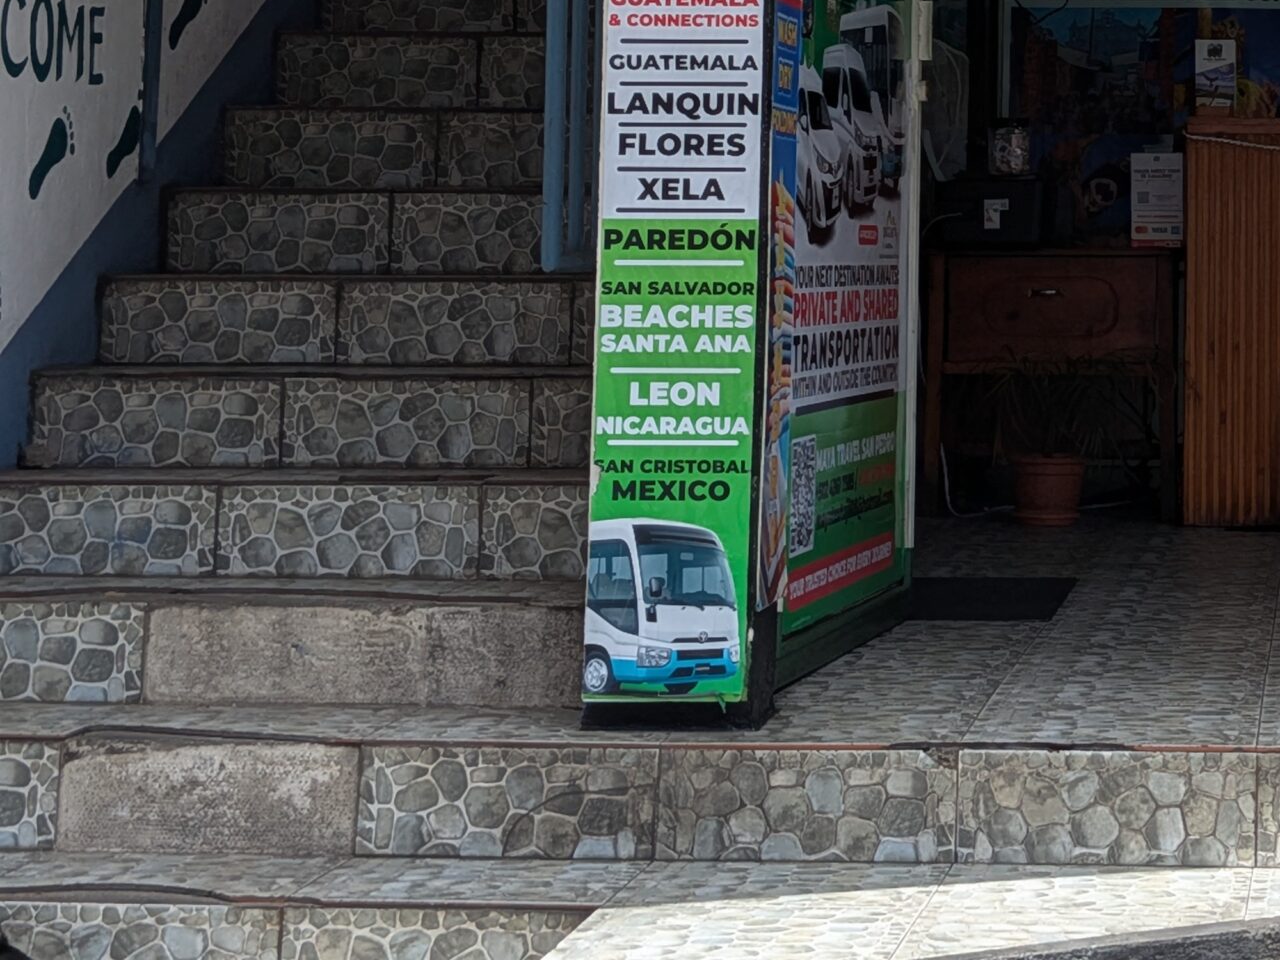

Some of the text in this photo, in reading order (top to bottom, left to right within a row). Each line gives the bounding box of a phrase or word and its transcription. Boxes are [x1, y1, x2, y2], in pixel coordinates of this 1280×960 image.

[609, 14, 759, 27] & CONNECTIONS
[609, 54, 758, 71] GUATEMALA
[608, 93, 759, 120] LANQUIN
[618, 133, 746, 156] FLORES
[637, 179, 724, 201] XELA
[604, 224, 756, 251] PAREDÓN
[795, 264, 875, 288] YOUR NEXT DESTINATION
[601, 281, 754, 296] SAN SALVADOR
[600, 305, 753, 328] BEACHES
[794, 289, 898, 328] PRIVATE AND SHARED
[601, 334, 751, 353] SANTA ANA
[794, 326, 899, 373] TRANSPORTATION
[629, 382, 720, 407] LEON
[596, 416, 749, 436] NICARAGUA
[594, 459, 750, 474] SAN CRISTOBAL
[611, 480, 730, 501] MEXICO
